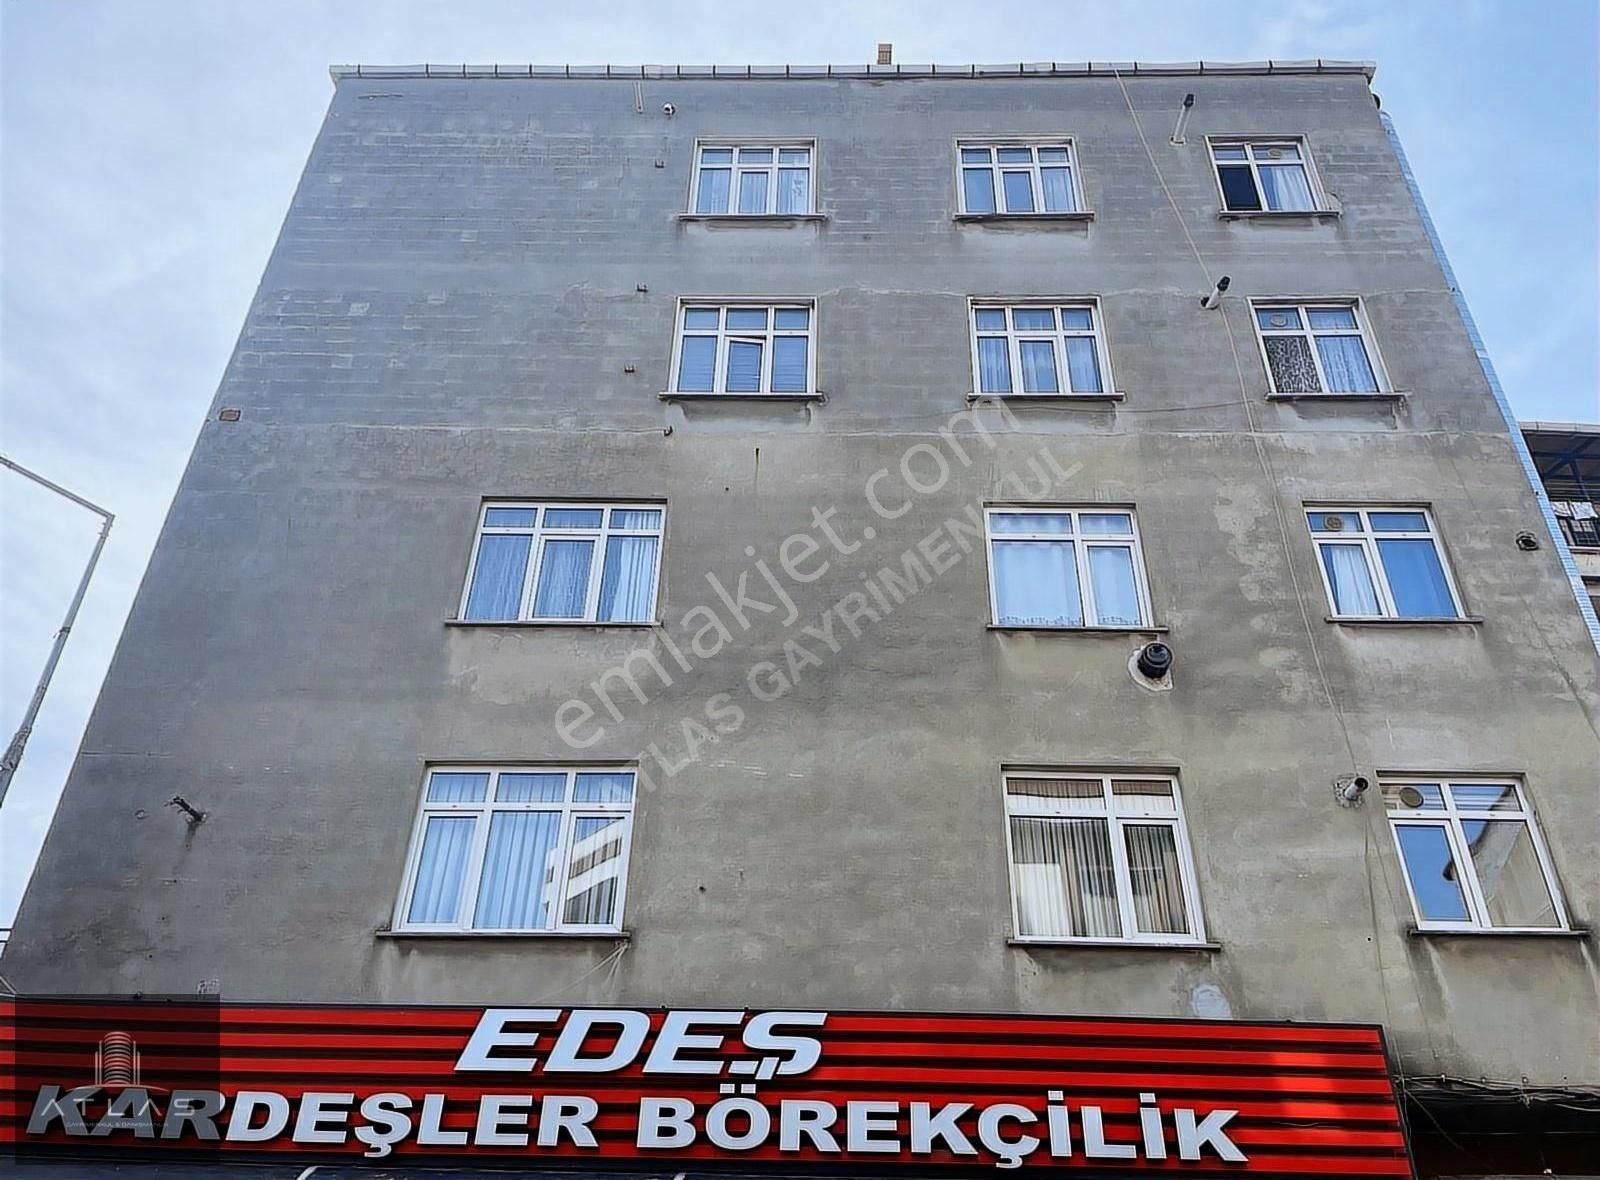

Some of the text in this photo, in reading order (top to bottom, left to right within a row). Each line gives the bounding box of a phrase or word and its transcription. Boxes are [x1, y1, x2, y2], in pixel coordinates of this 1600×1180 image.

[455, 1008, 827, 1081] EDEŞ
[26, 1083, 1249, 1169] KARDEŞLER BÖREKÇİLİK
